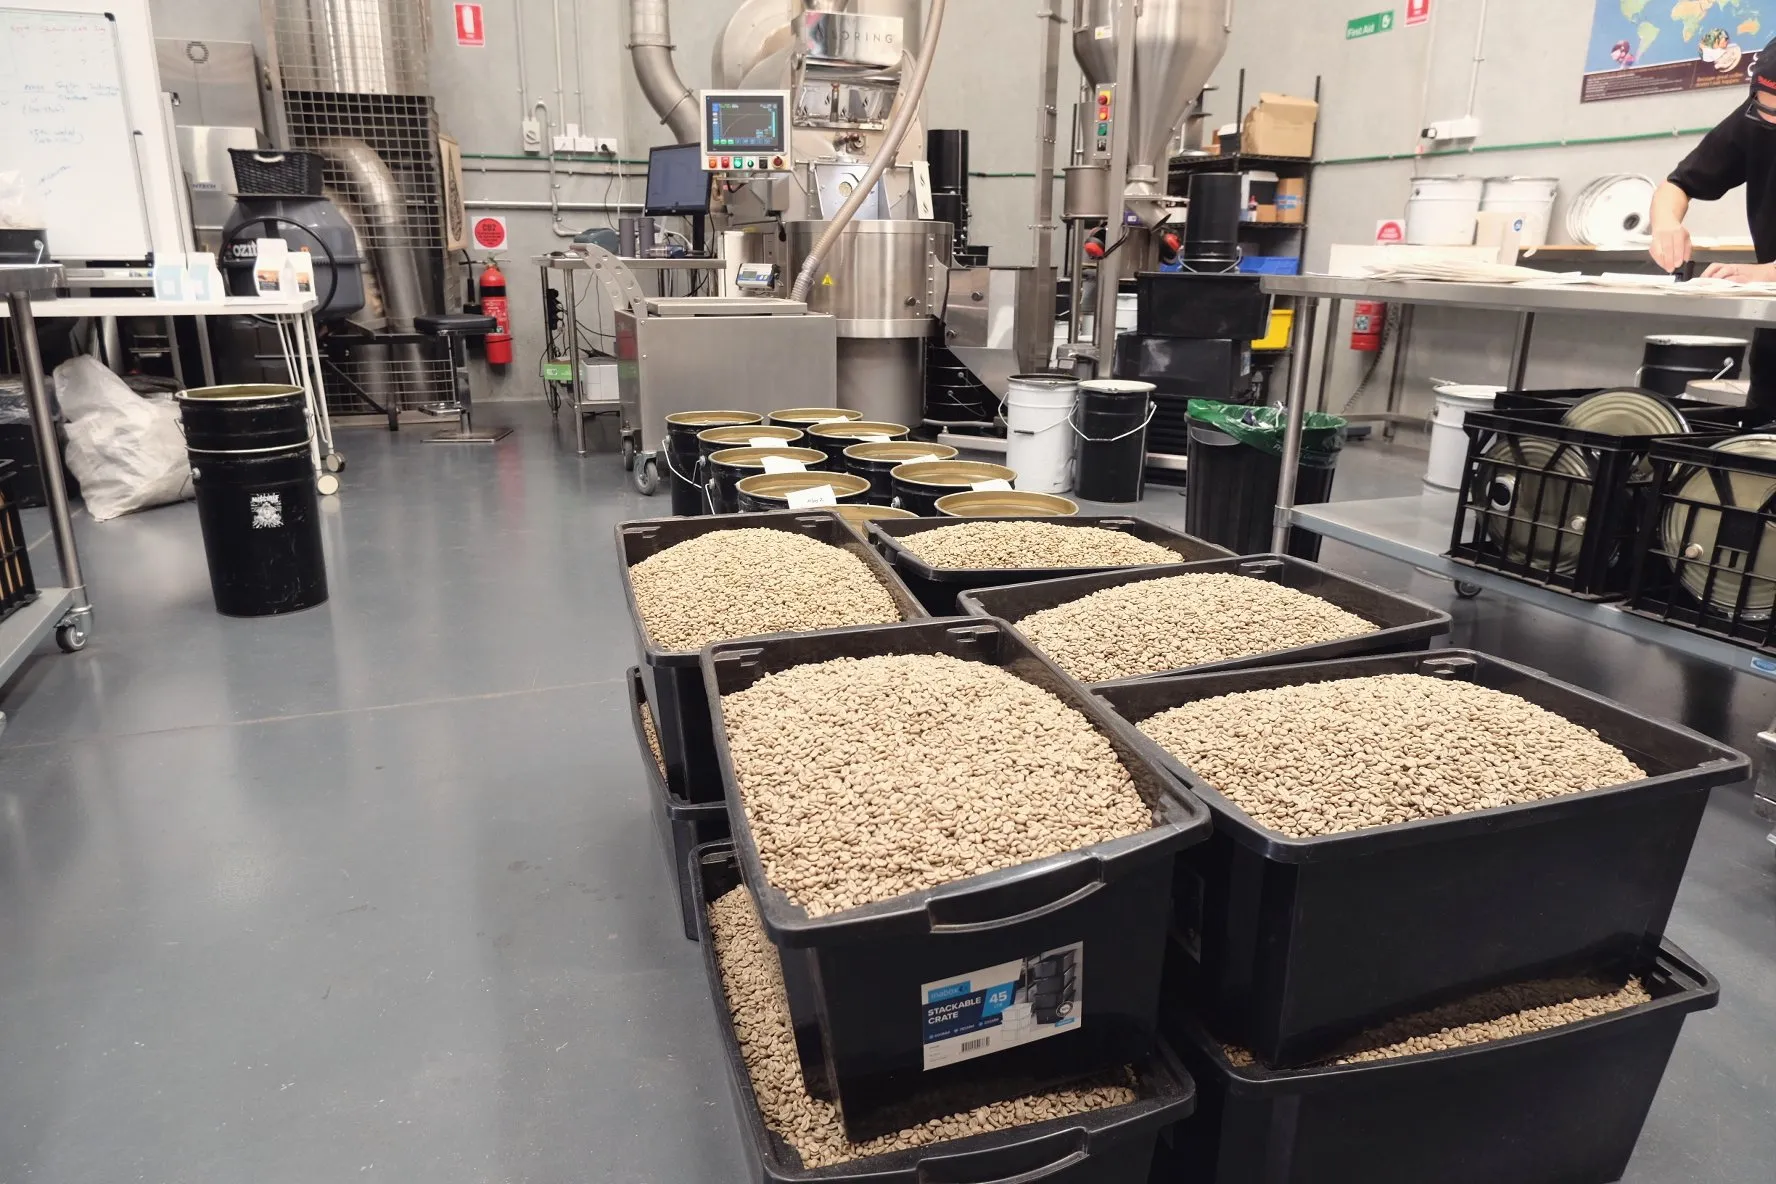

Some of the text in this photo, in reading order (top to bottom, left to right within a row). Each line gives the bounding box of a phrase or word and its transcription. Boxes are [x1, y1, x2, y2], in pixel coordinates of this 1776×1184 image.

[831, 30, 893, 44] LORING
[1347, 23, 1375, 37] First Aid
[989, 990, 1008, 1003] 45
[927, 996, 982, 1017] STACKABLE
[928, 1010, 959, 1025] CRATE
